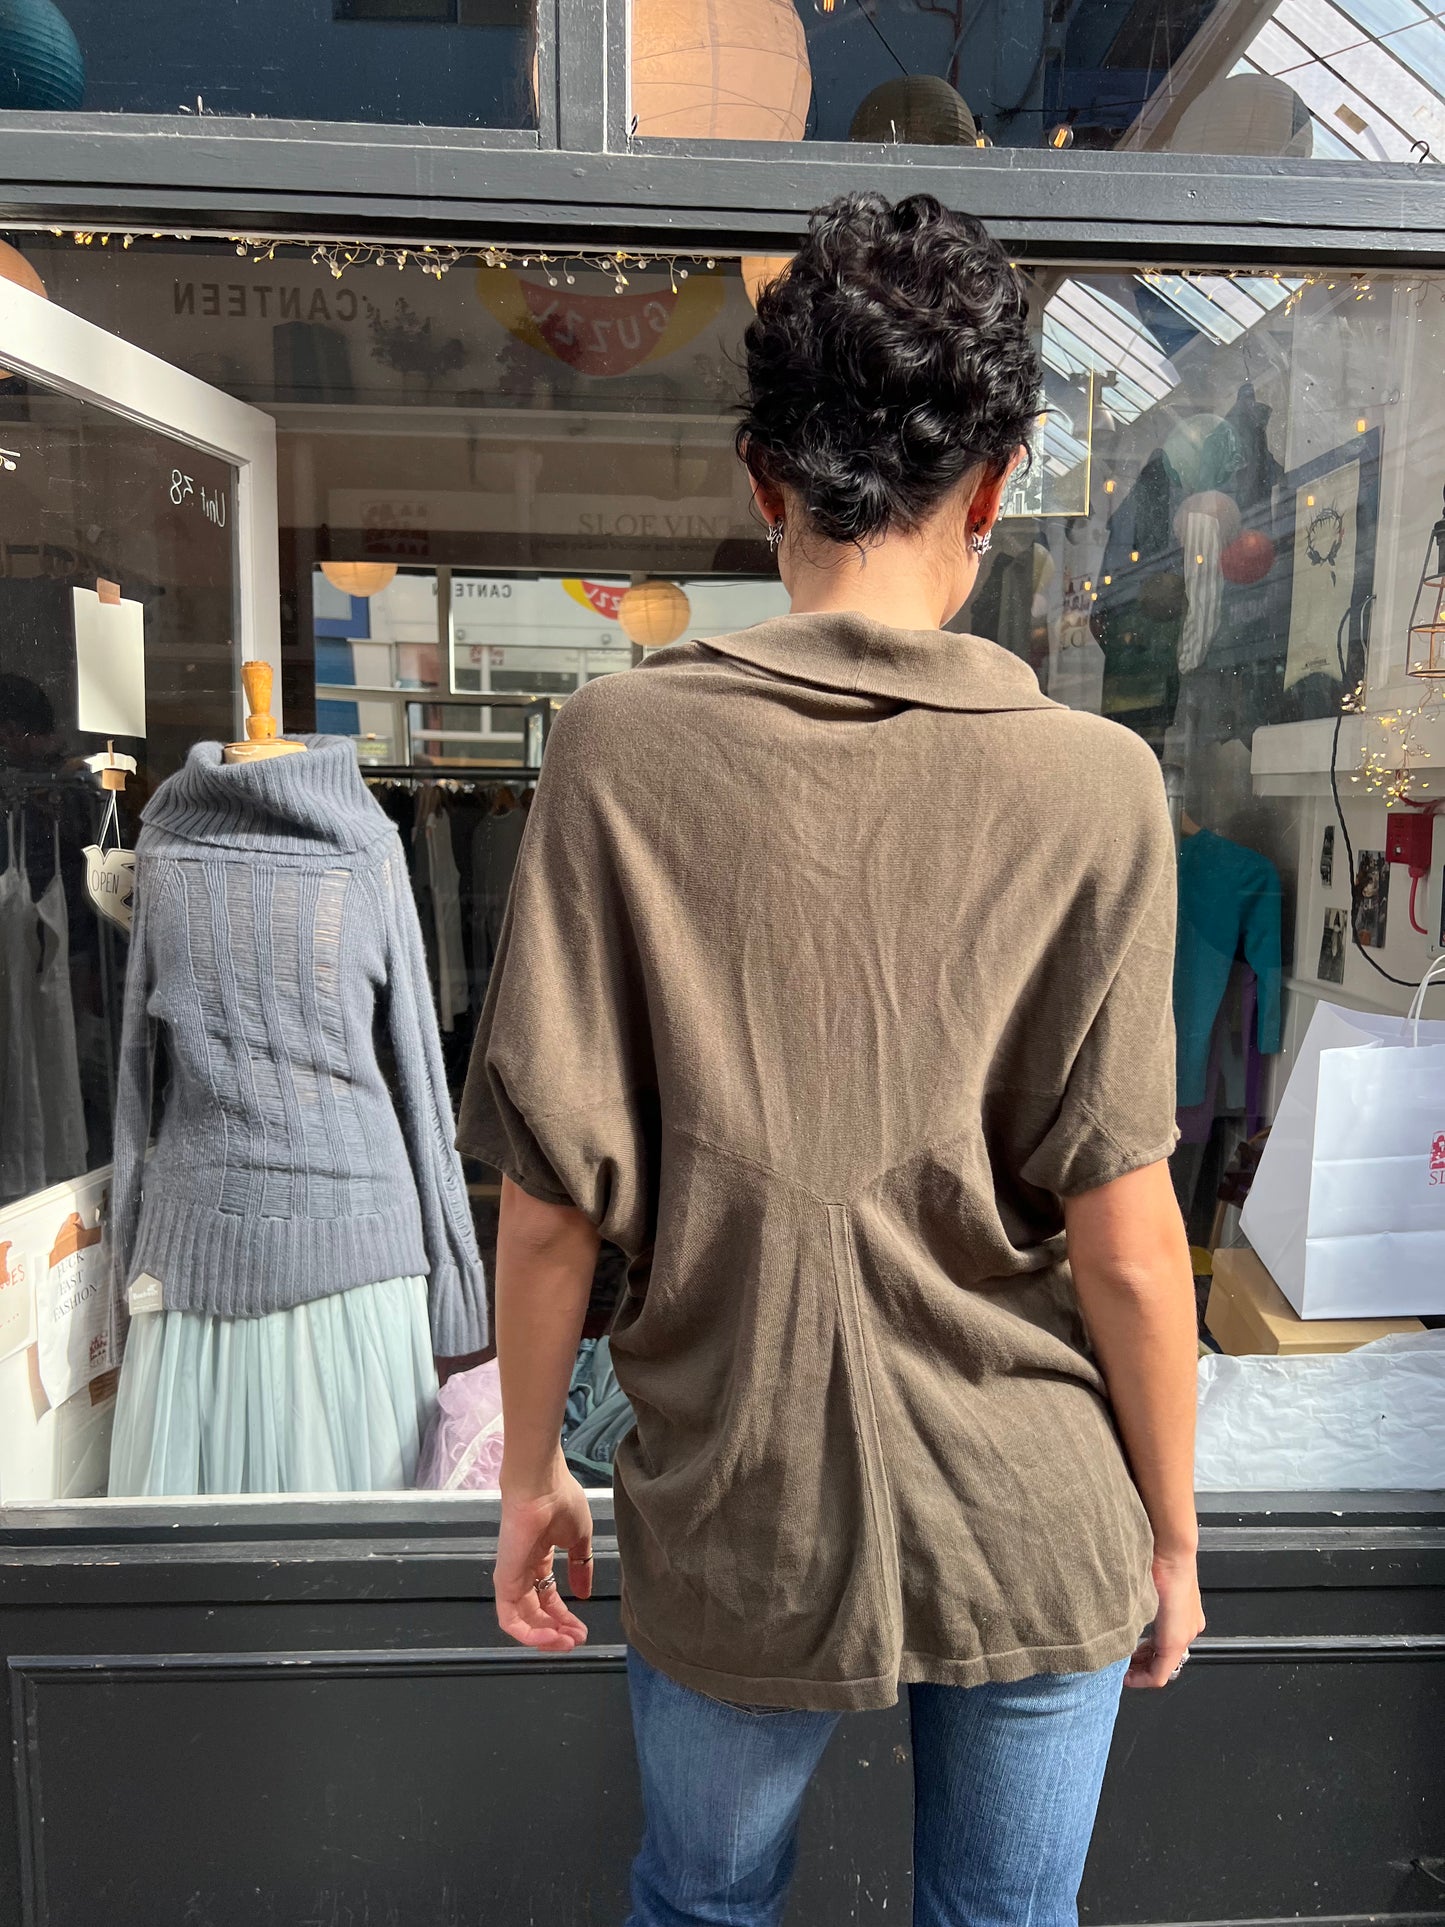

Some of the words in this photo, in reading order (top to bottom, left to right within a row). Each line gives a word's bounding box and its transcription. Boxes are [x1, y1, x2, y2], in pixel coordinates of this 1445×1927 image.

[92, 869, 120, 895] OPEN
[57, 1251, 85, 1279] FUCK
[57, 1269, 84, 1297] FAST
[53, 1281, 98, 1322] FASHION
